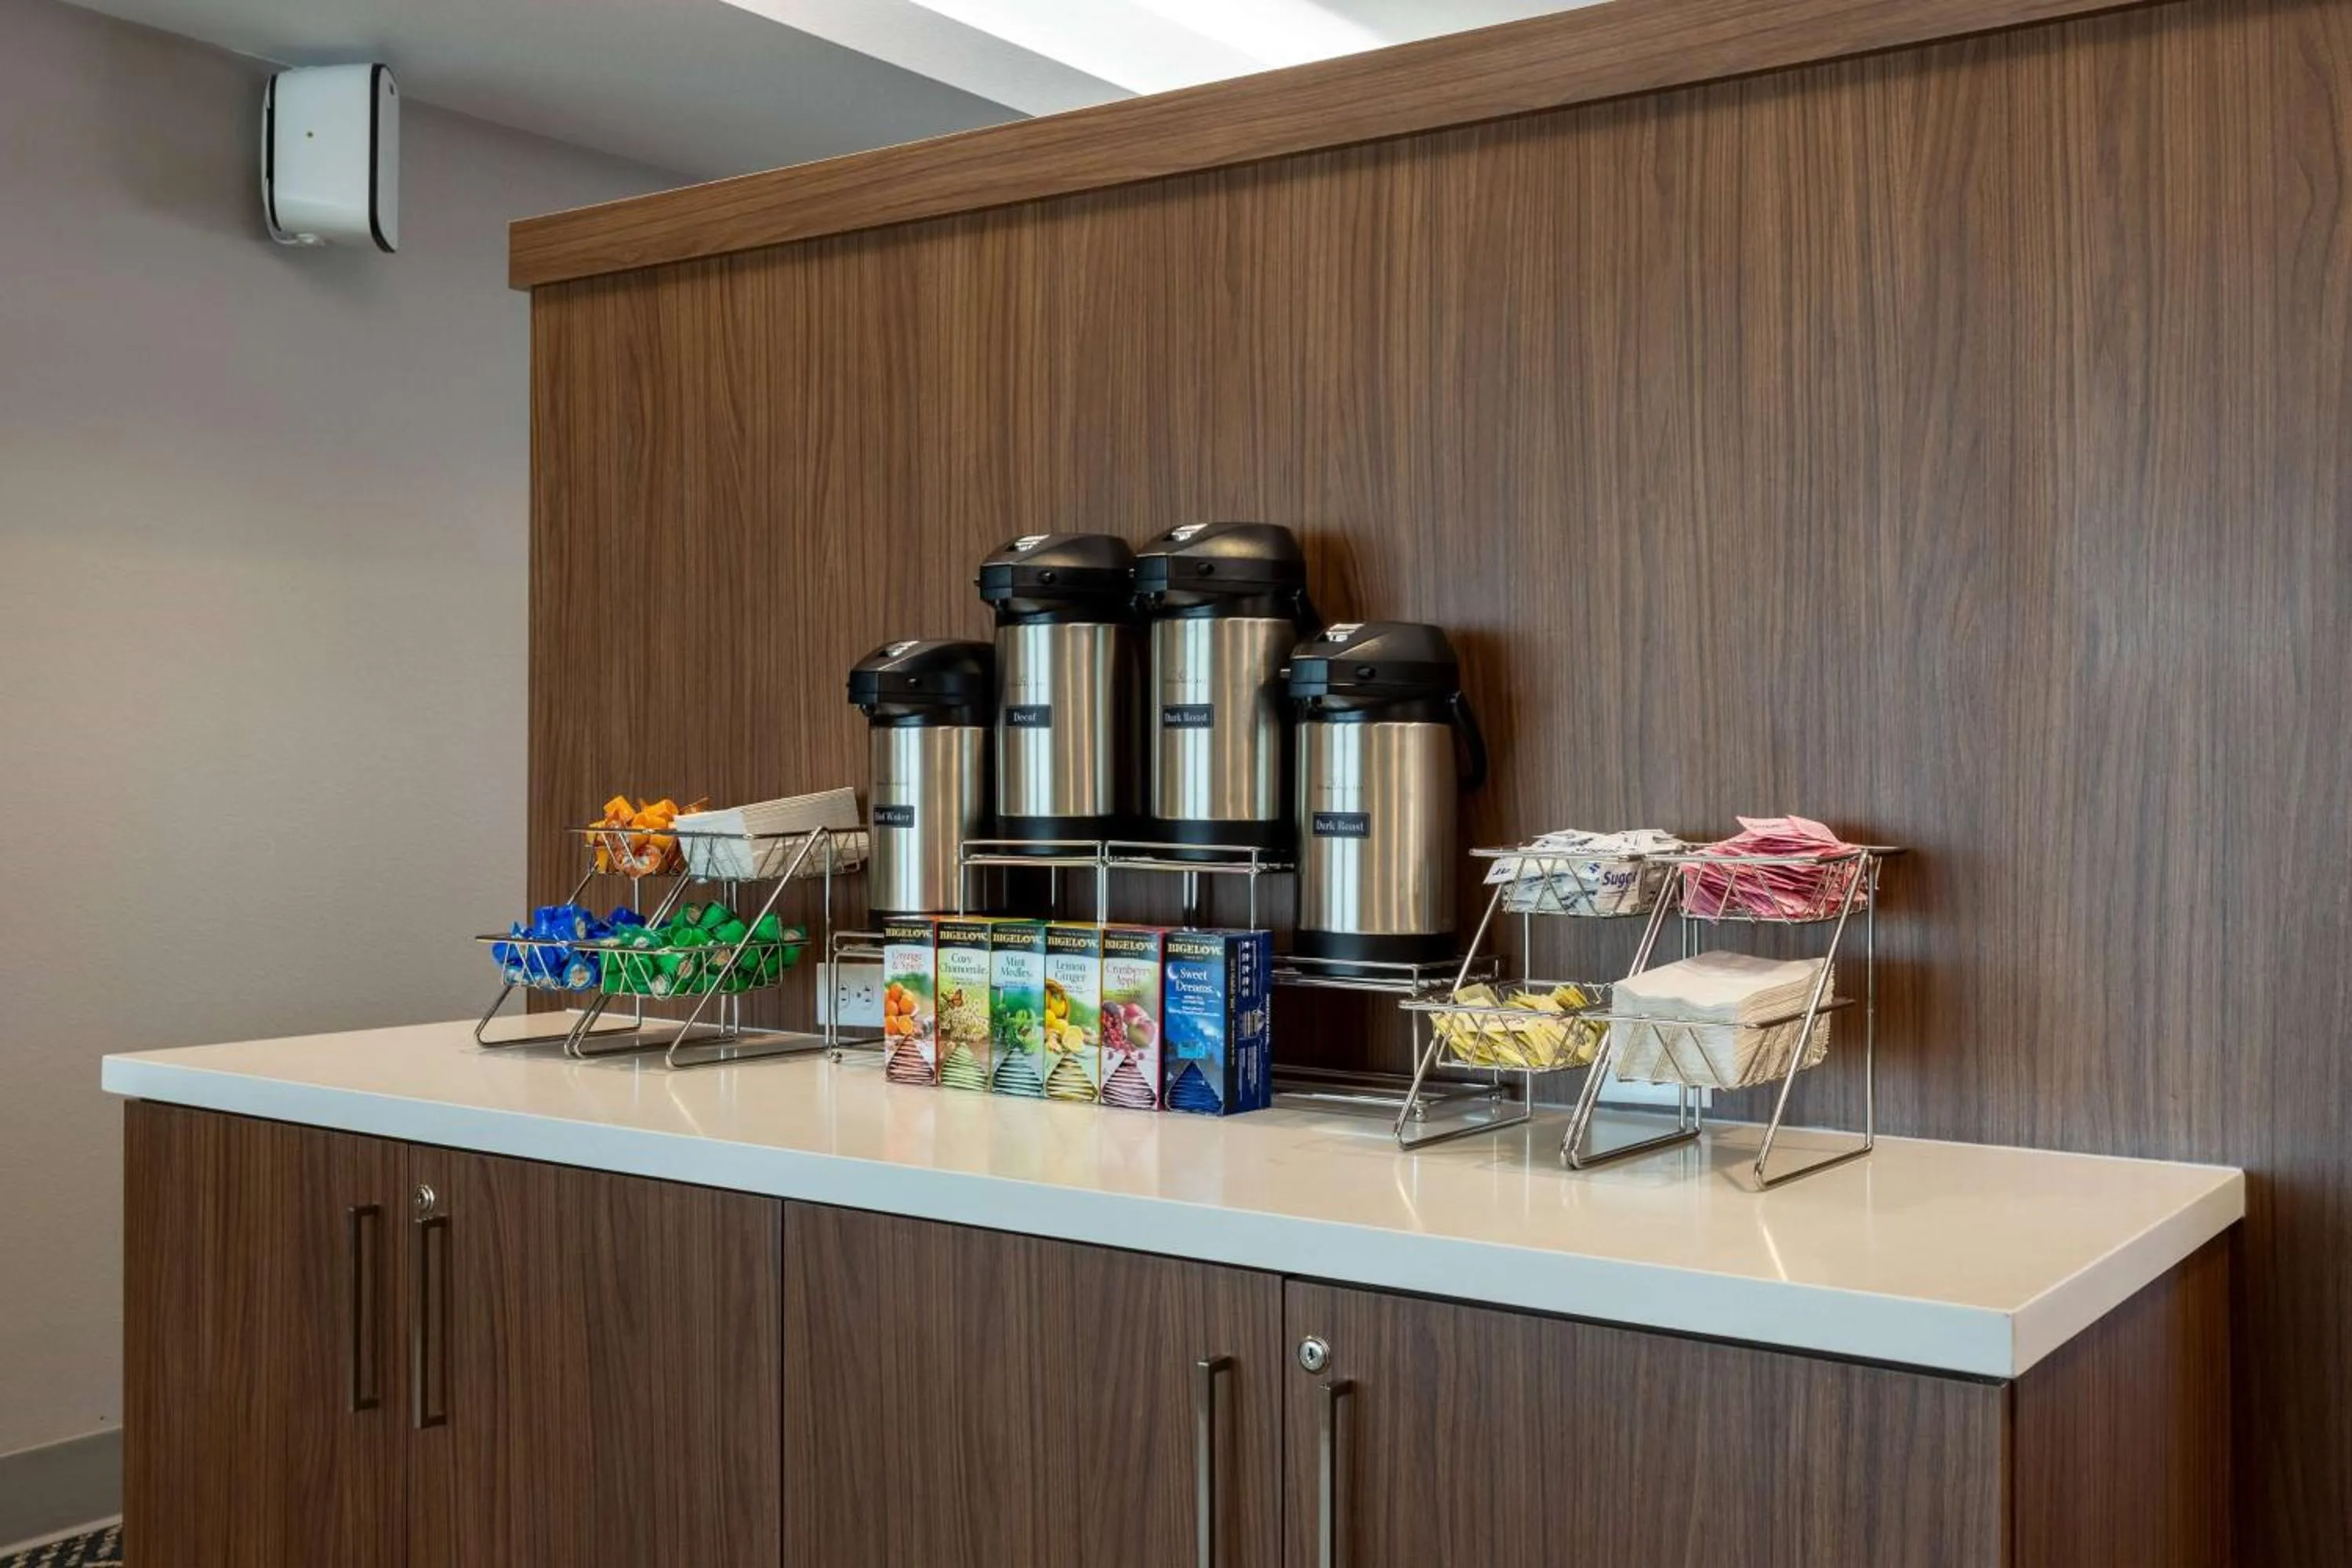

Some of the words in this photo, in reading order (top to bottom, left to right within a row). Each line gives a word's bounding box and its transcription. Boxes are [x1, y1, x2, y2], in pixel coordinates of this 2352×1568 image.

[1014, 712, 1036, 722] Decaf
[1164, 713, 1181, 722] Dark
[1183, 712, 1207, 722] Roast
[887, 811, 909, 822] Water
[1316, 820, 1335, 831] Dark
[1338, 820, 1363, 832] Roast
[885, 927, 931, 938] BIGELOW
[940, 931, 985, 942] BIGELOW
[993, 933, 1042, 944] BIGELOW
[1047, 936, 1096, 948] BIGELOW
[1105, 940, 1156, 952] BIGELOW
[1167, 942, 1223, 955] BIGELOW
[951, 953, 972, 964] Cozy
[1006, 956, 1025, 967] Mint
[1056, 959, 1086, 972] Lemon
[1180, 967, 1208, 981] Sweet
